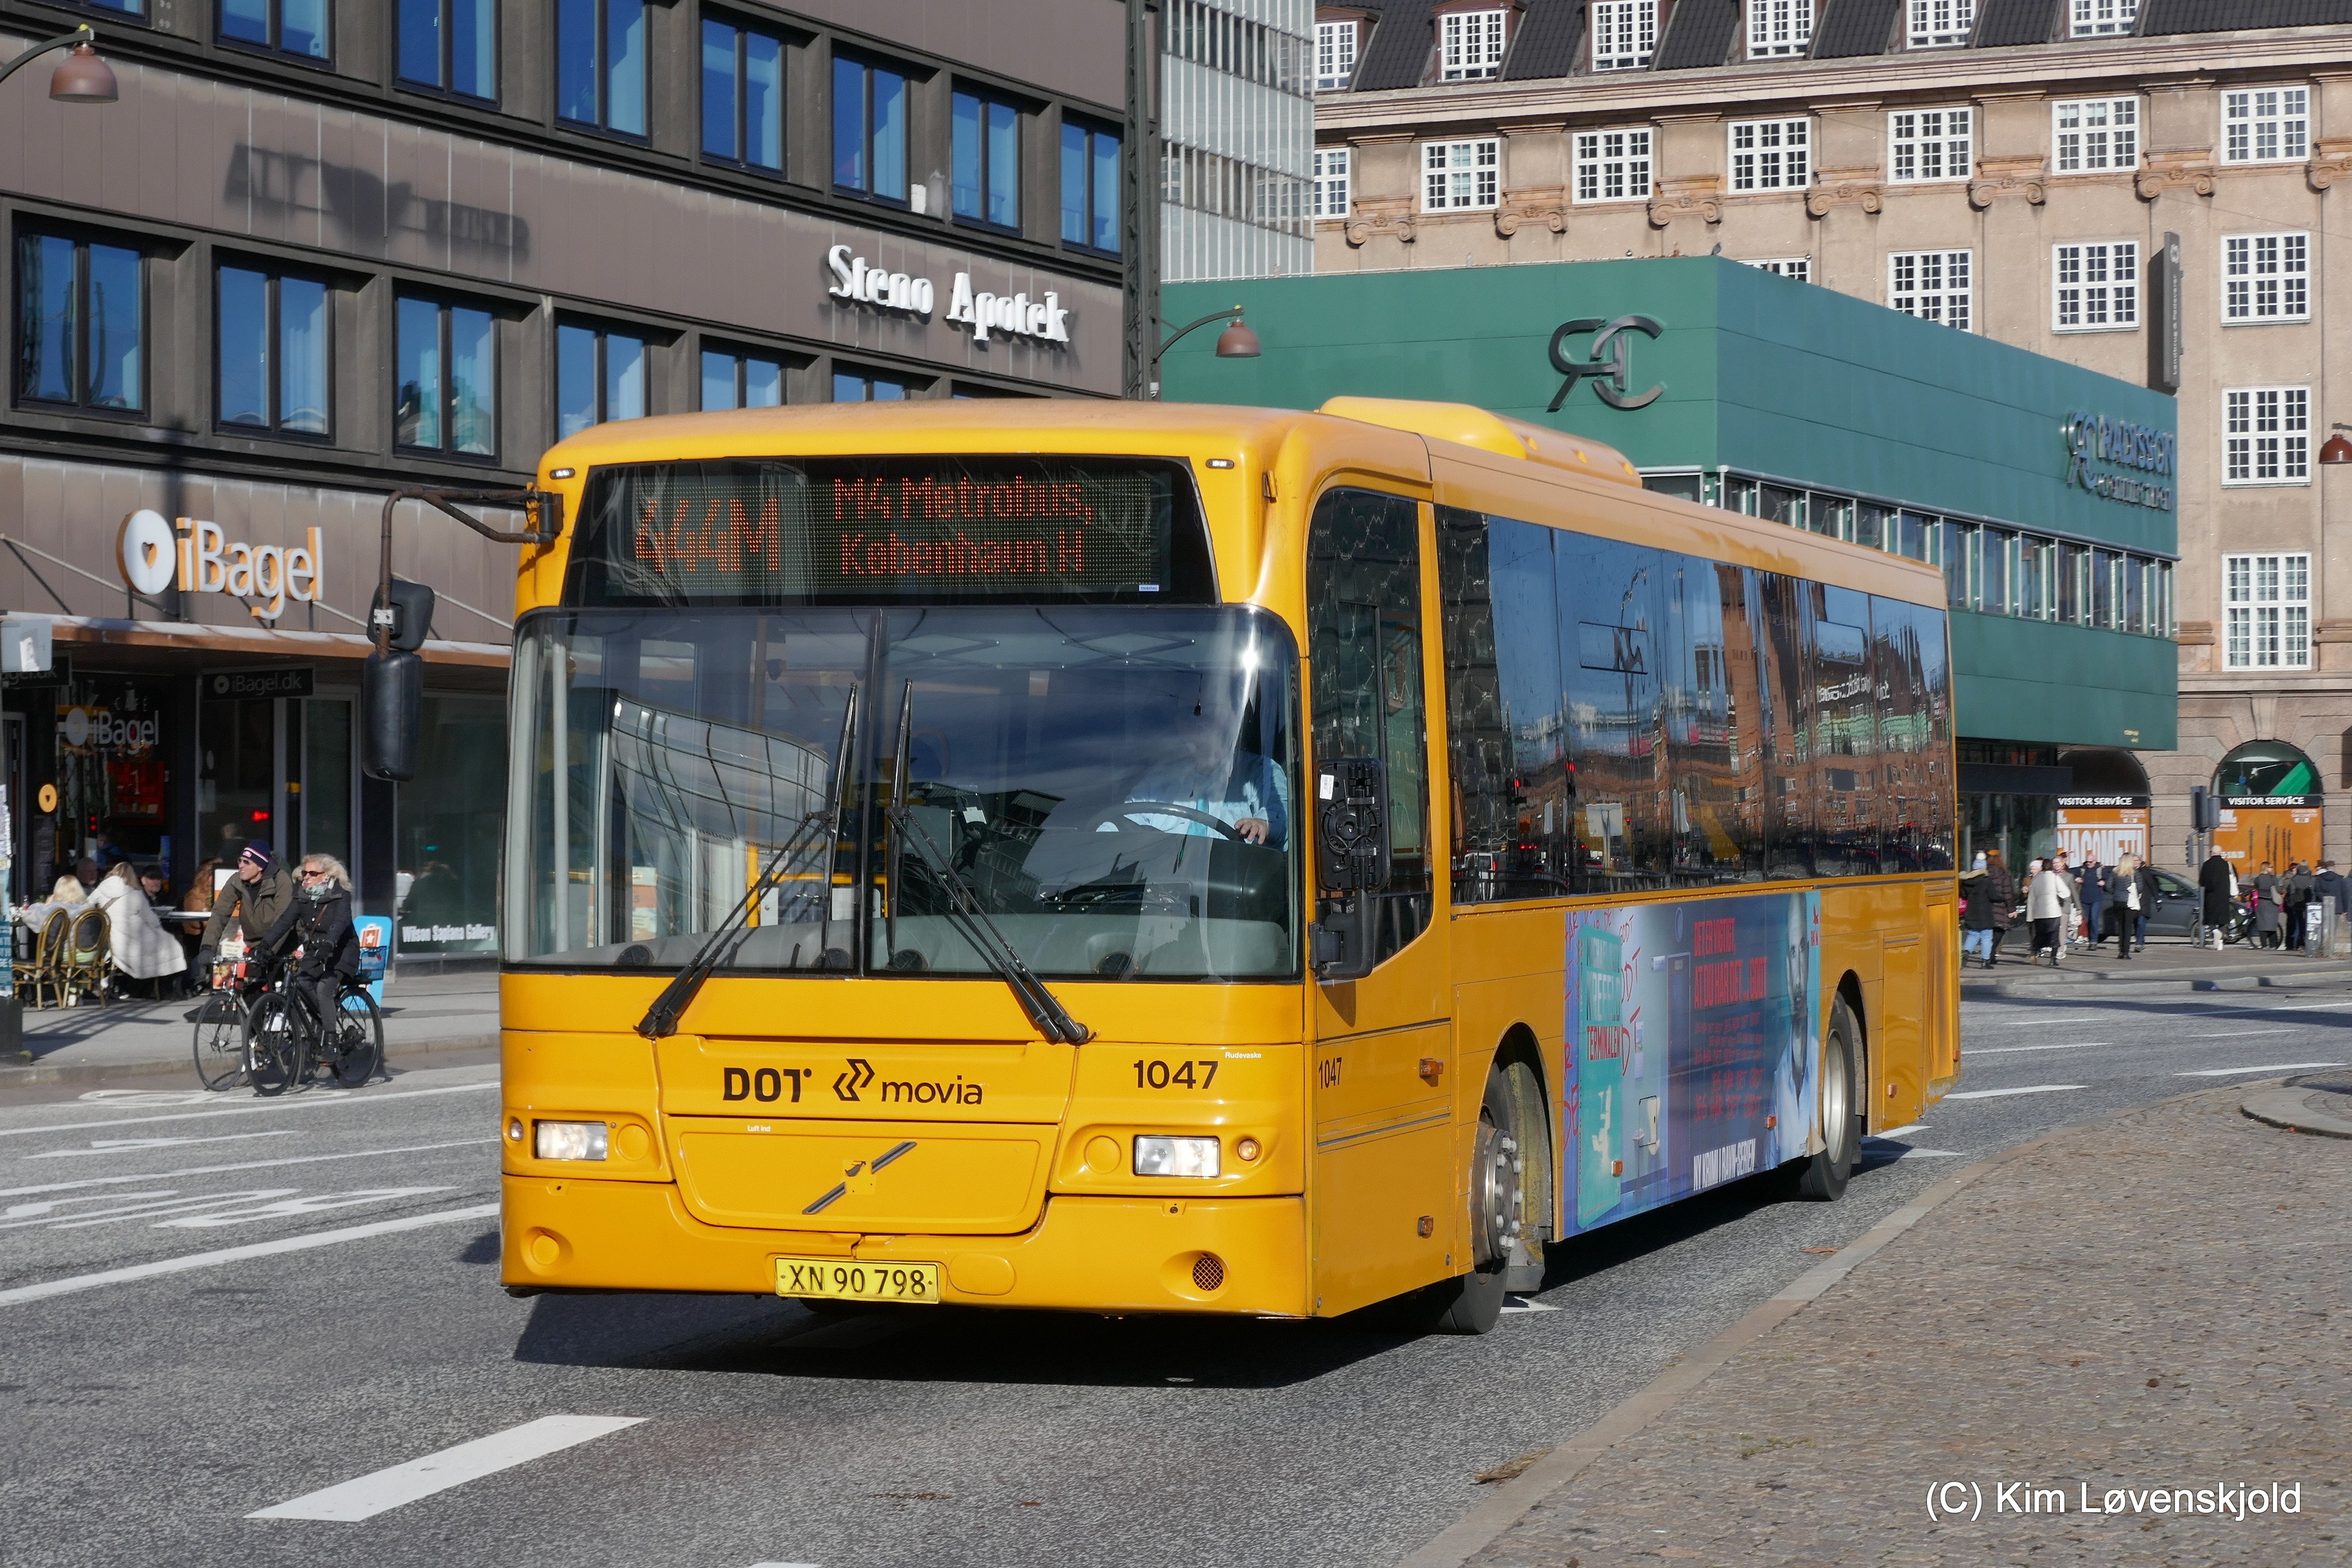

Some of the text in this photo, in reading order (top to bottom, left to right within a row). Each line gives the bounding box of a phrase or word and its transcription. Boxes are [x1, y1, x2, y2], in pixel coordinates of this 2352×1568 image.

[829, 244, 1069, 342] Steno Apotek
[834, 474, 1094, 526] M4 Metrobus,
[635, 497, 780, 572] 444M
[1058, 529, 1084, 573] H
[176, 516, 324, 620] iBagel
[93, 710, 160, 755] iBagel
[2057, 797, 2093, 805] VISITOR
[2227, 797, 2264, 805] VISITOR
[402, 925, 431, 942] Wilson
[466, 923, 495, 941] Gallery
[1586, 1026, 1621, 1061] TERMINALEN
[723, 1067, 812, 1103] DOT
[881, 1075, 983, 1105] movia
[1133, 1060, 1218, 1089] 1047
[1319, 1057, 1342, 1089] 1047
[1694, 1154, 1702, 1191] NY
[1702, 1149, 1718, 1189] KRIMI
[1722, 1138, 1757, 1182] RAVN-SERIEN
[789, 1264, 926, 1297] XN 90 798
